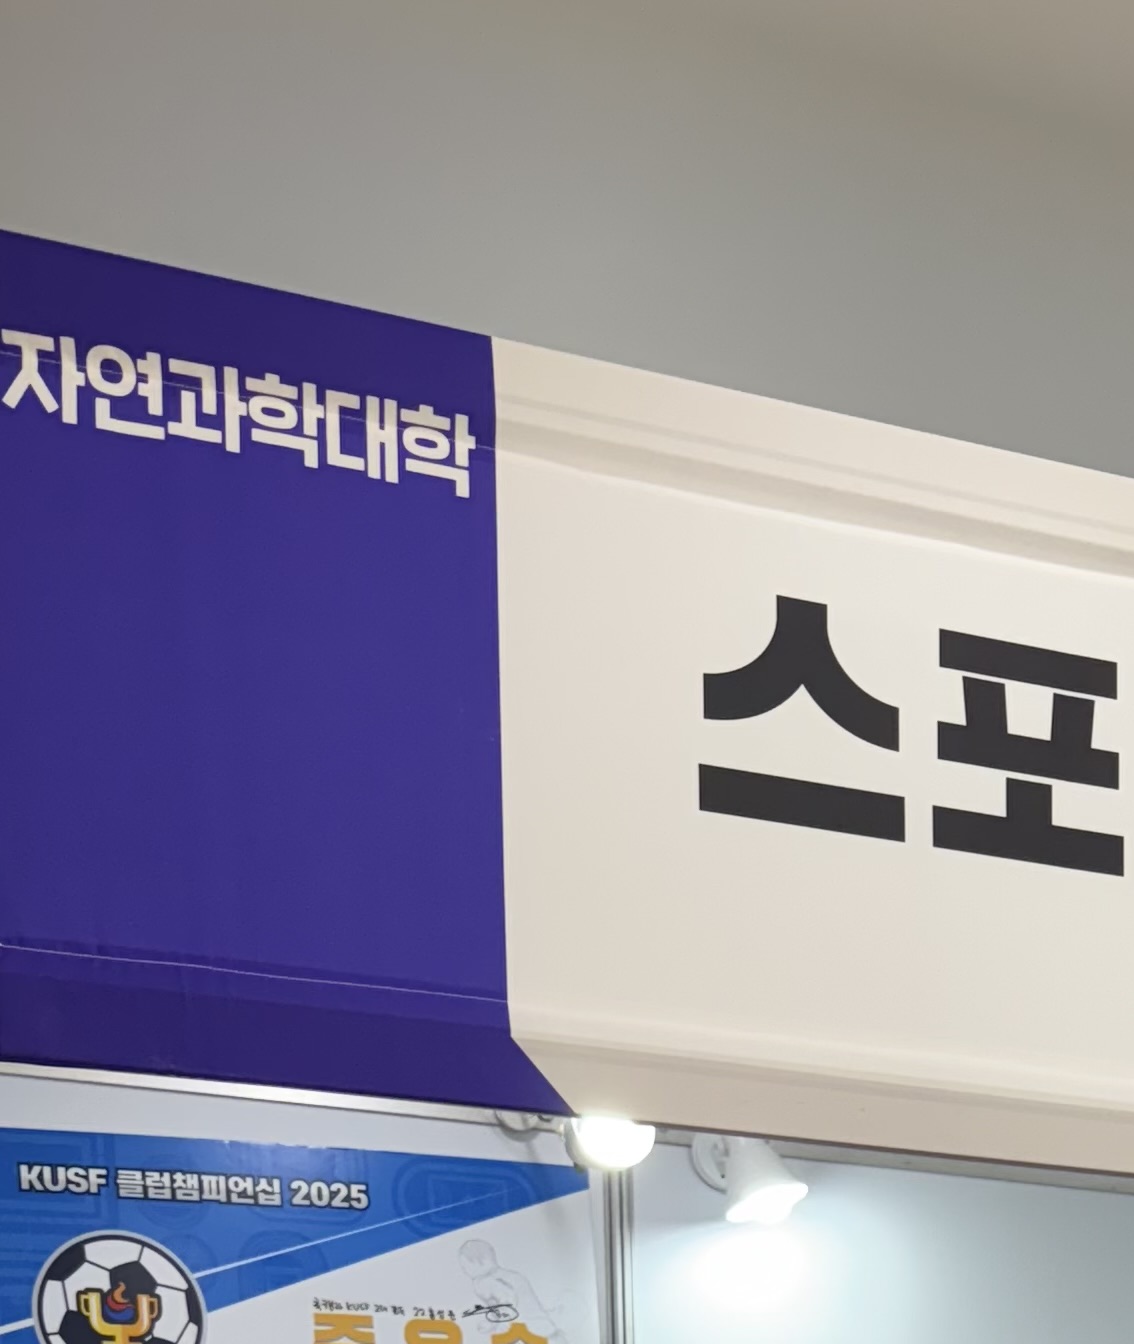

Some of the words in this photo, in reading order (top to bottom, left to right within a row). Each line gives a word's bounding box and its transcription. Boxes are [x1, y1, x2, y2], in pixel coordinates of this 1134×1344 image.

[0, 327, 476, 498] 자연과학대학
[18, 1162, 108, 1194] KUSF
[116, 1168, 282, 1207] 클럽챔피언십
[289, 1179, 371, 1211] 2025
